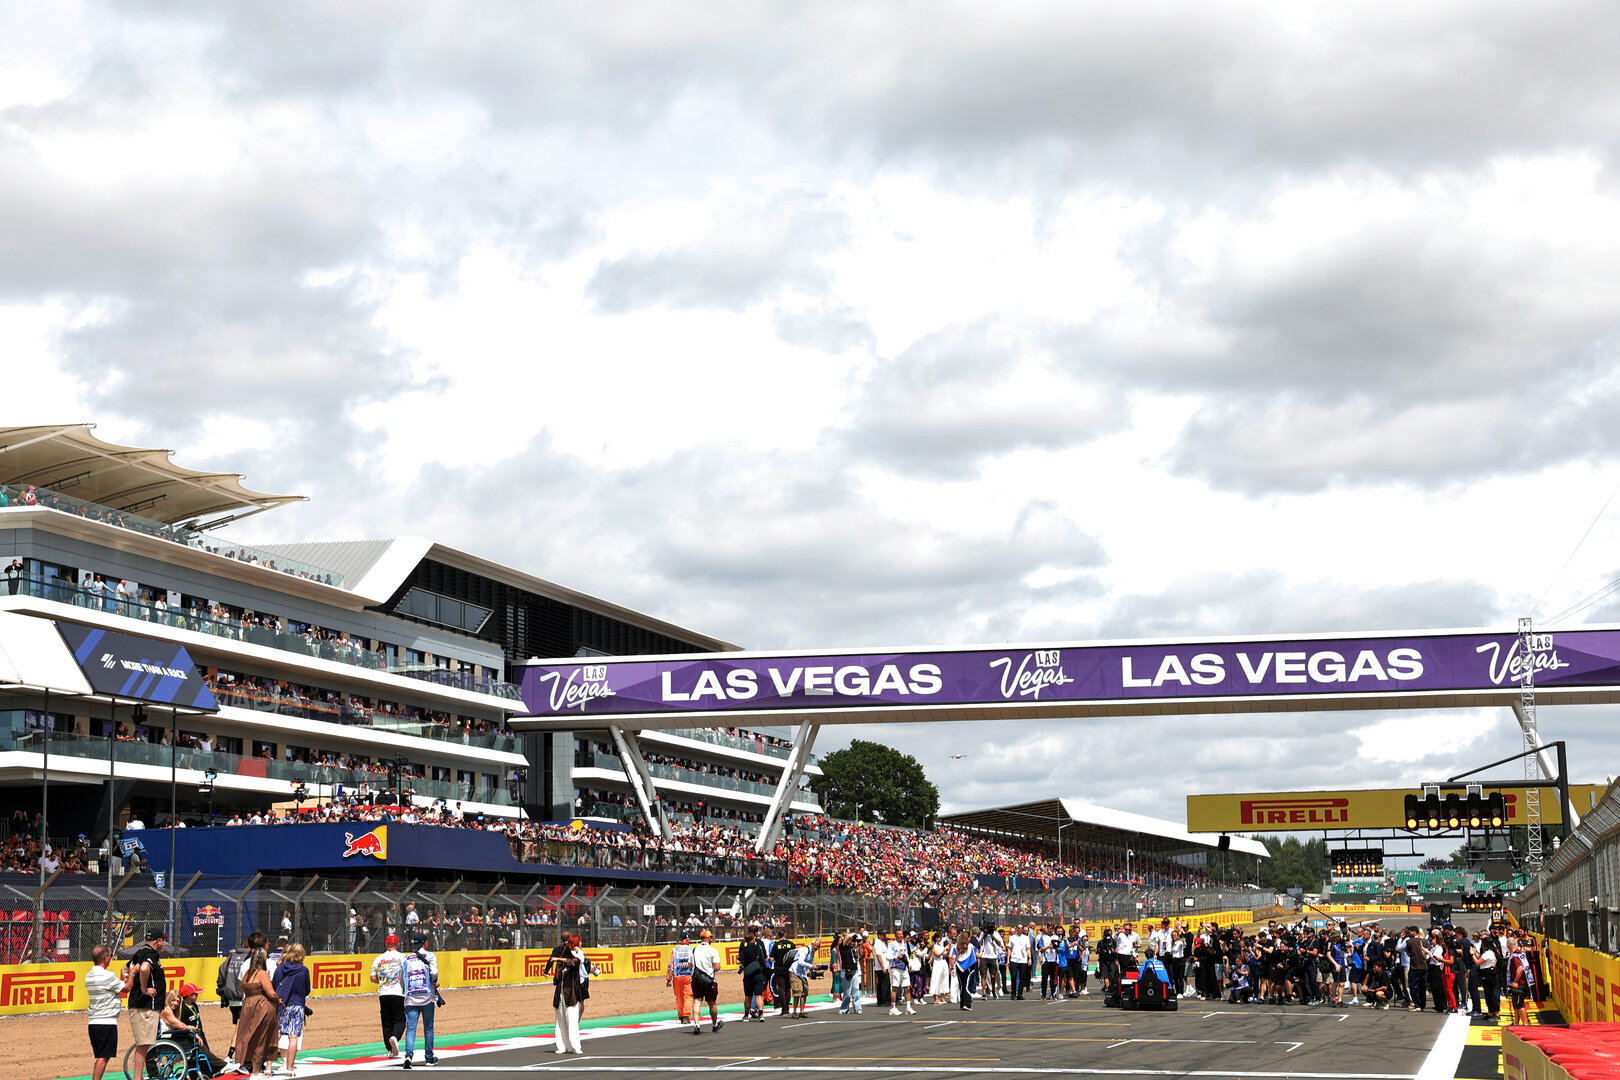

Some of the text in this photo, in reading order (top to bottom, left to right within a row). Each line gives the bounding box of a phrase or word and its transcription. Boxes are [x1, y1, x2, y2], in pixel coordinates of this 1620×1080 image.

[1531, 636, 1552, 650] LAS
[120, 659, 144, 672] MORE
[167, 668, 188, 679] RACE
[1037, 652, 1058, 666] LAS
[1122, 648, 1424, 688] LAS VEGAS
[1476, 638, 1569, 685] Vegas
[585, 667, 605, 681] LAS
[661, 663, 943, 701] LAS VEGAS
[990, 653, 1074, 700] Vegas
[539, 669, 616, 711] Vegas
[1240, 798, 1349, 824] PIRELLI
[193, 916, 224, 925] Red Bull
[313, 961, 362, 989] PIRELLI
[463, 956, 501, 980] PIRELLI
[632, 951, 661, 973] PIRELLI
[1, 971, 76, 1006] PIRELLI
